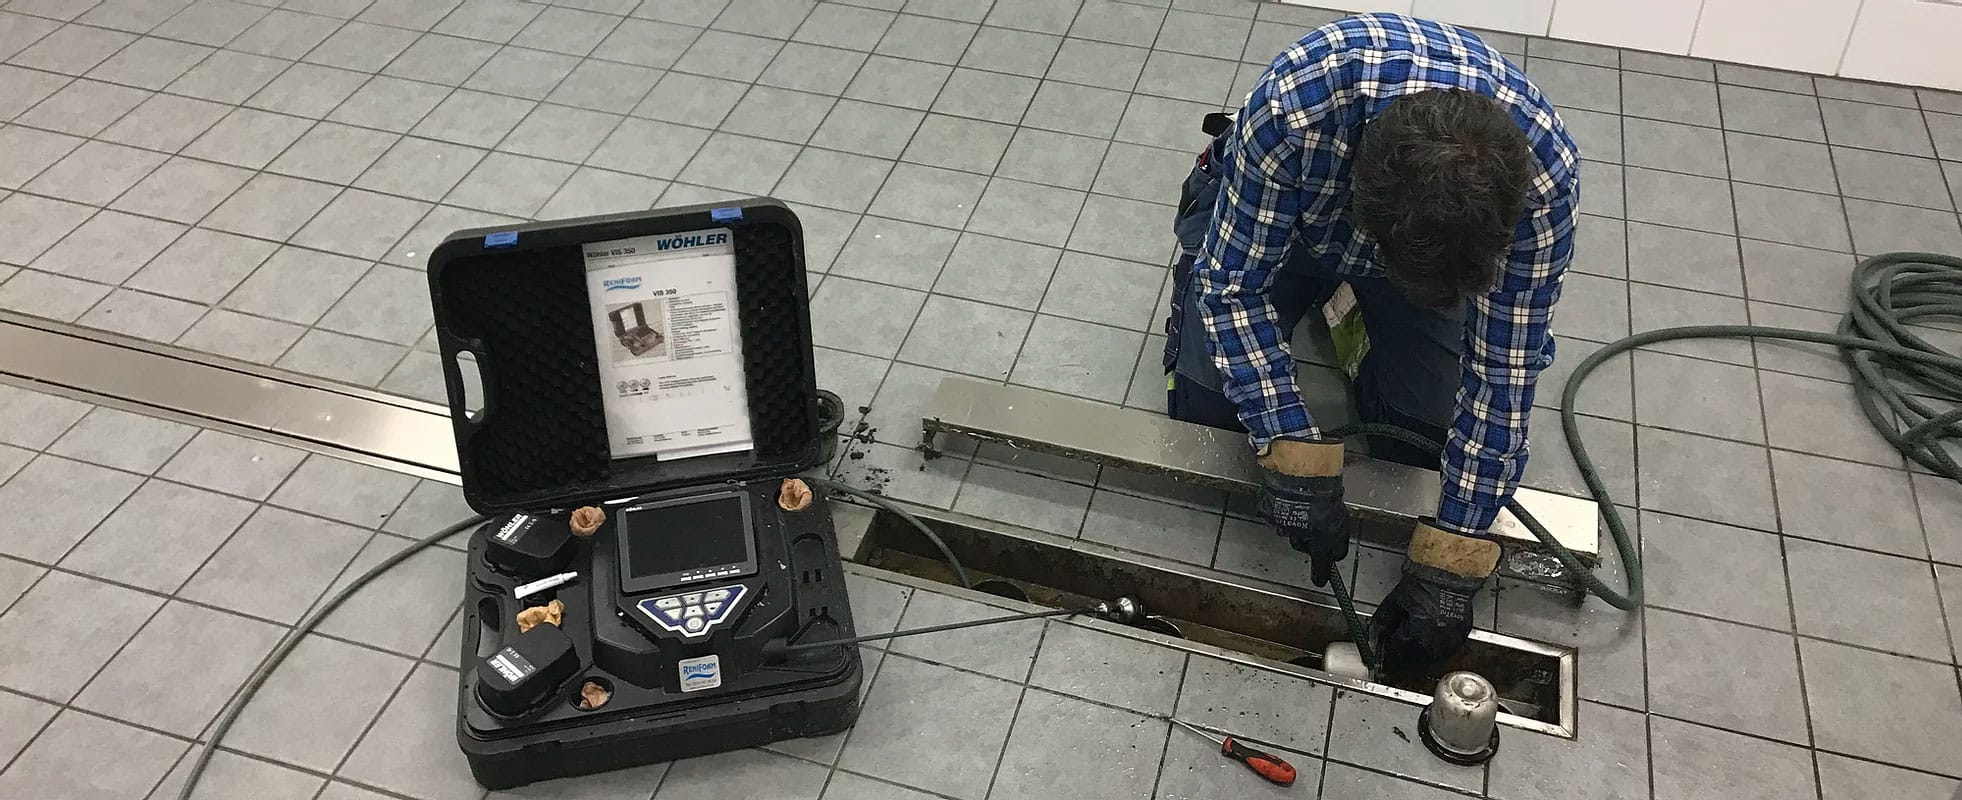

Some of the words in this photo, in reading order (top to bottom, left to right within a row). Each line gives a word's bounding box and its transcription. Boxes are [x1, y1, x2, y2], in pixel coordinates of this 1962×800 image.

[656, 233, 727, 251] WÖHLER
[623, 247, 636, 255] 350
[665, 288, 677, 296] 350
[495, 513, 523, 539] WÖHLER
